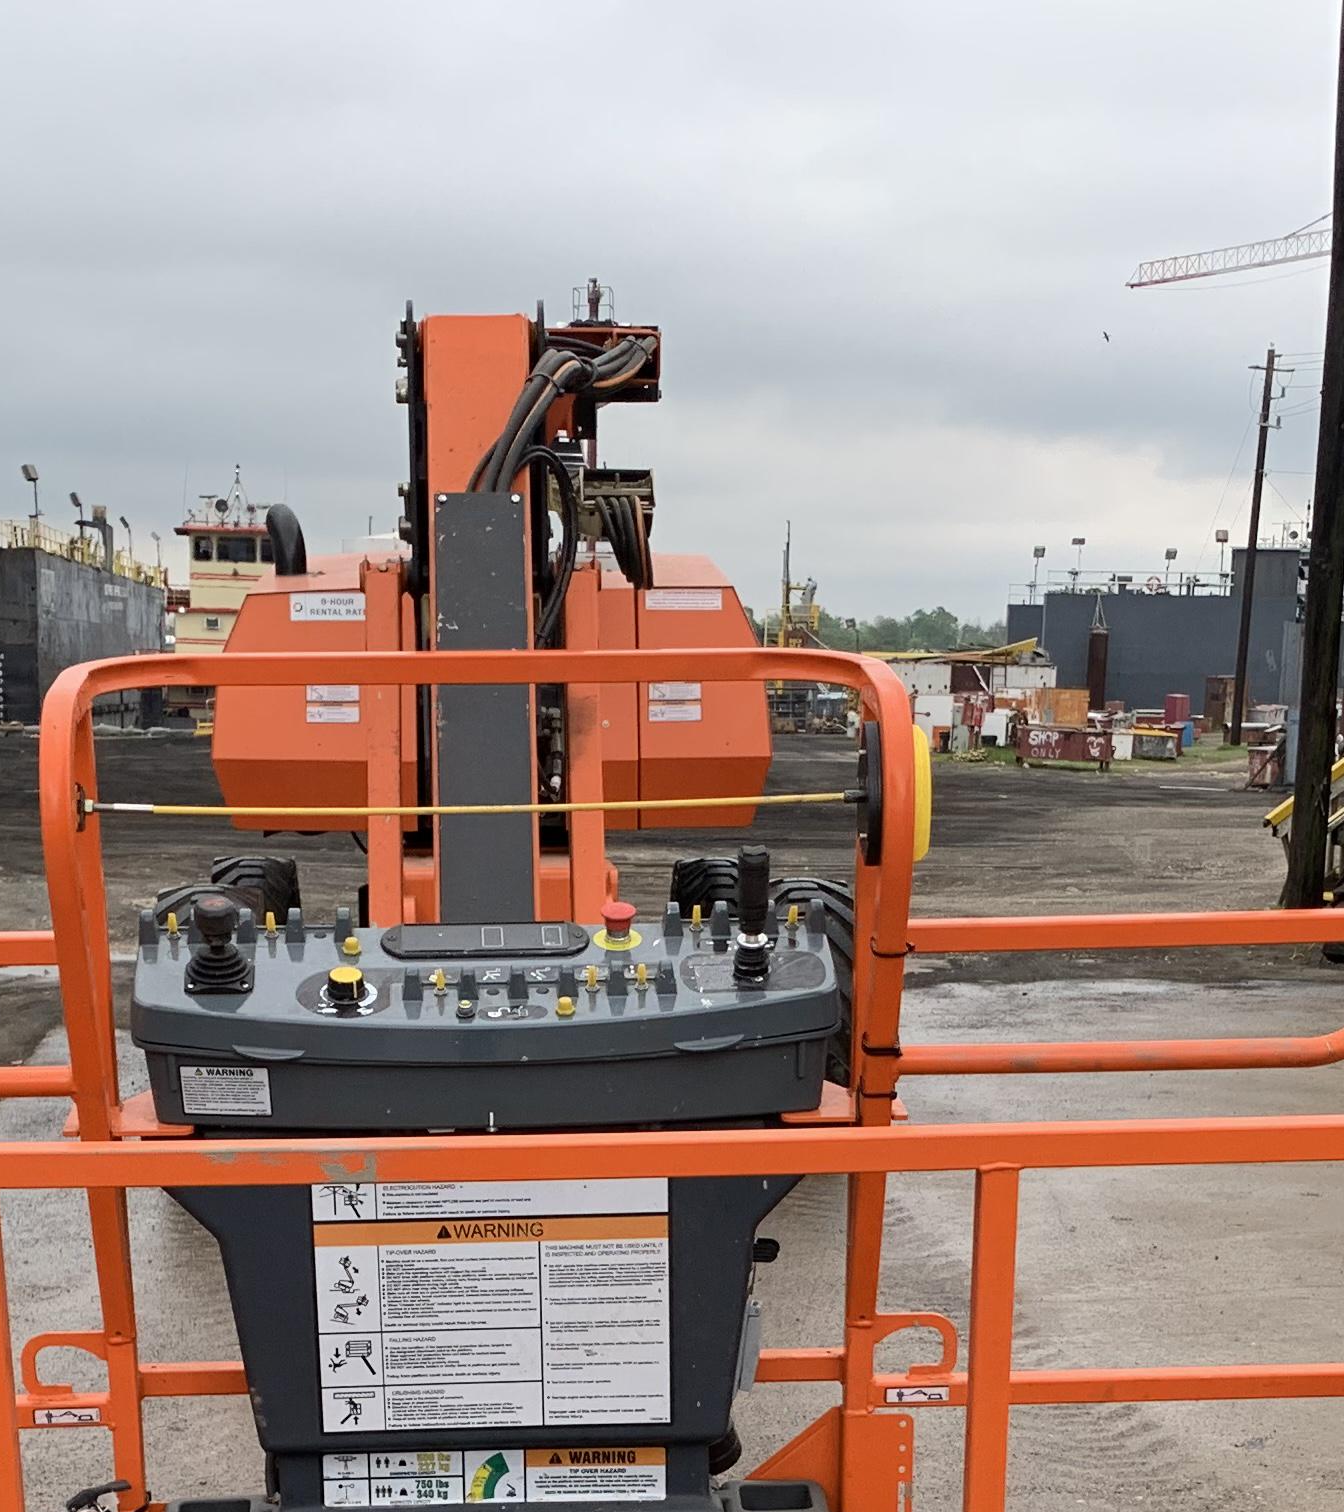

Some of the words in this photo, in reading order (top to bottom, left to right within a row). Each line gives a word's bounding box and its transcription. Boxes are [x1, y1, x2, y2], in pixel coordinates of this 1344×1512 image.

[309, 608, 343, 616] RENTAL
[1028, 730, 1059, 747] SHOP
[1030, 747, 1062, 758] ONLY
[205, 1067, 254, 1077] WARNING
[453, 1222, 544, 1239] WARNING
[568, 1450, 637, 1465] WARNING
[415, 1479, 433, 1489] 750
[435, 1479, 449, 1489] lbs
[416, 1489, 435, 1499] 340
[437, 1489, 449, 1500] kg
